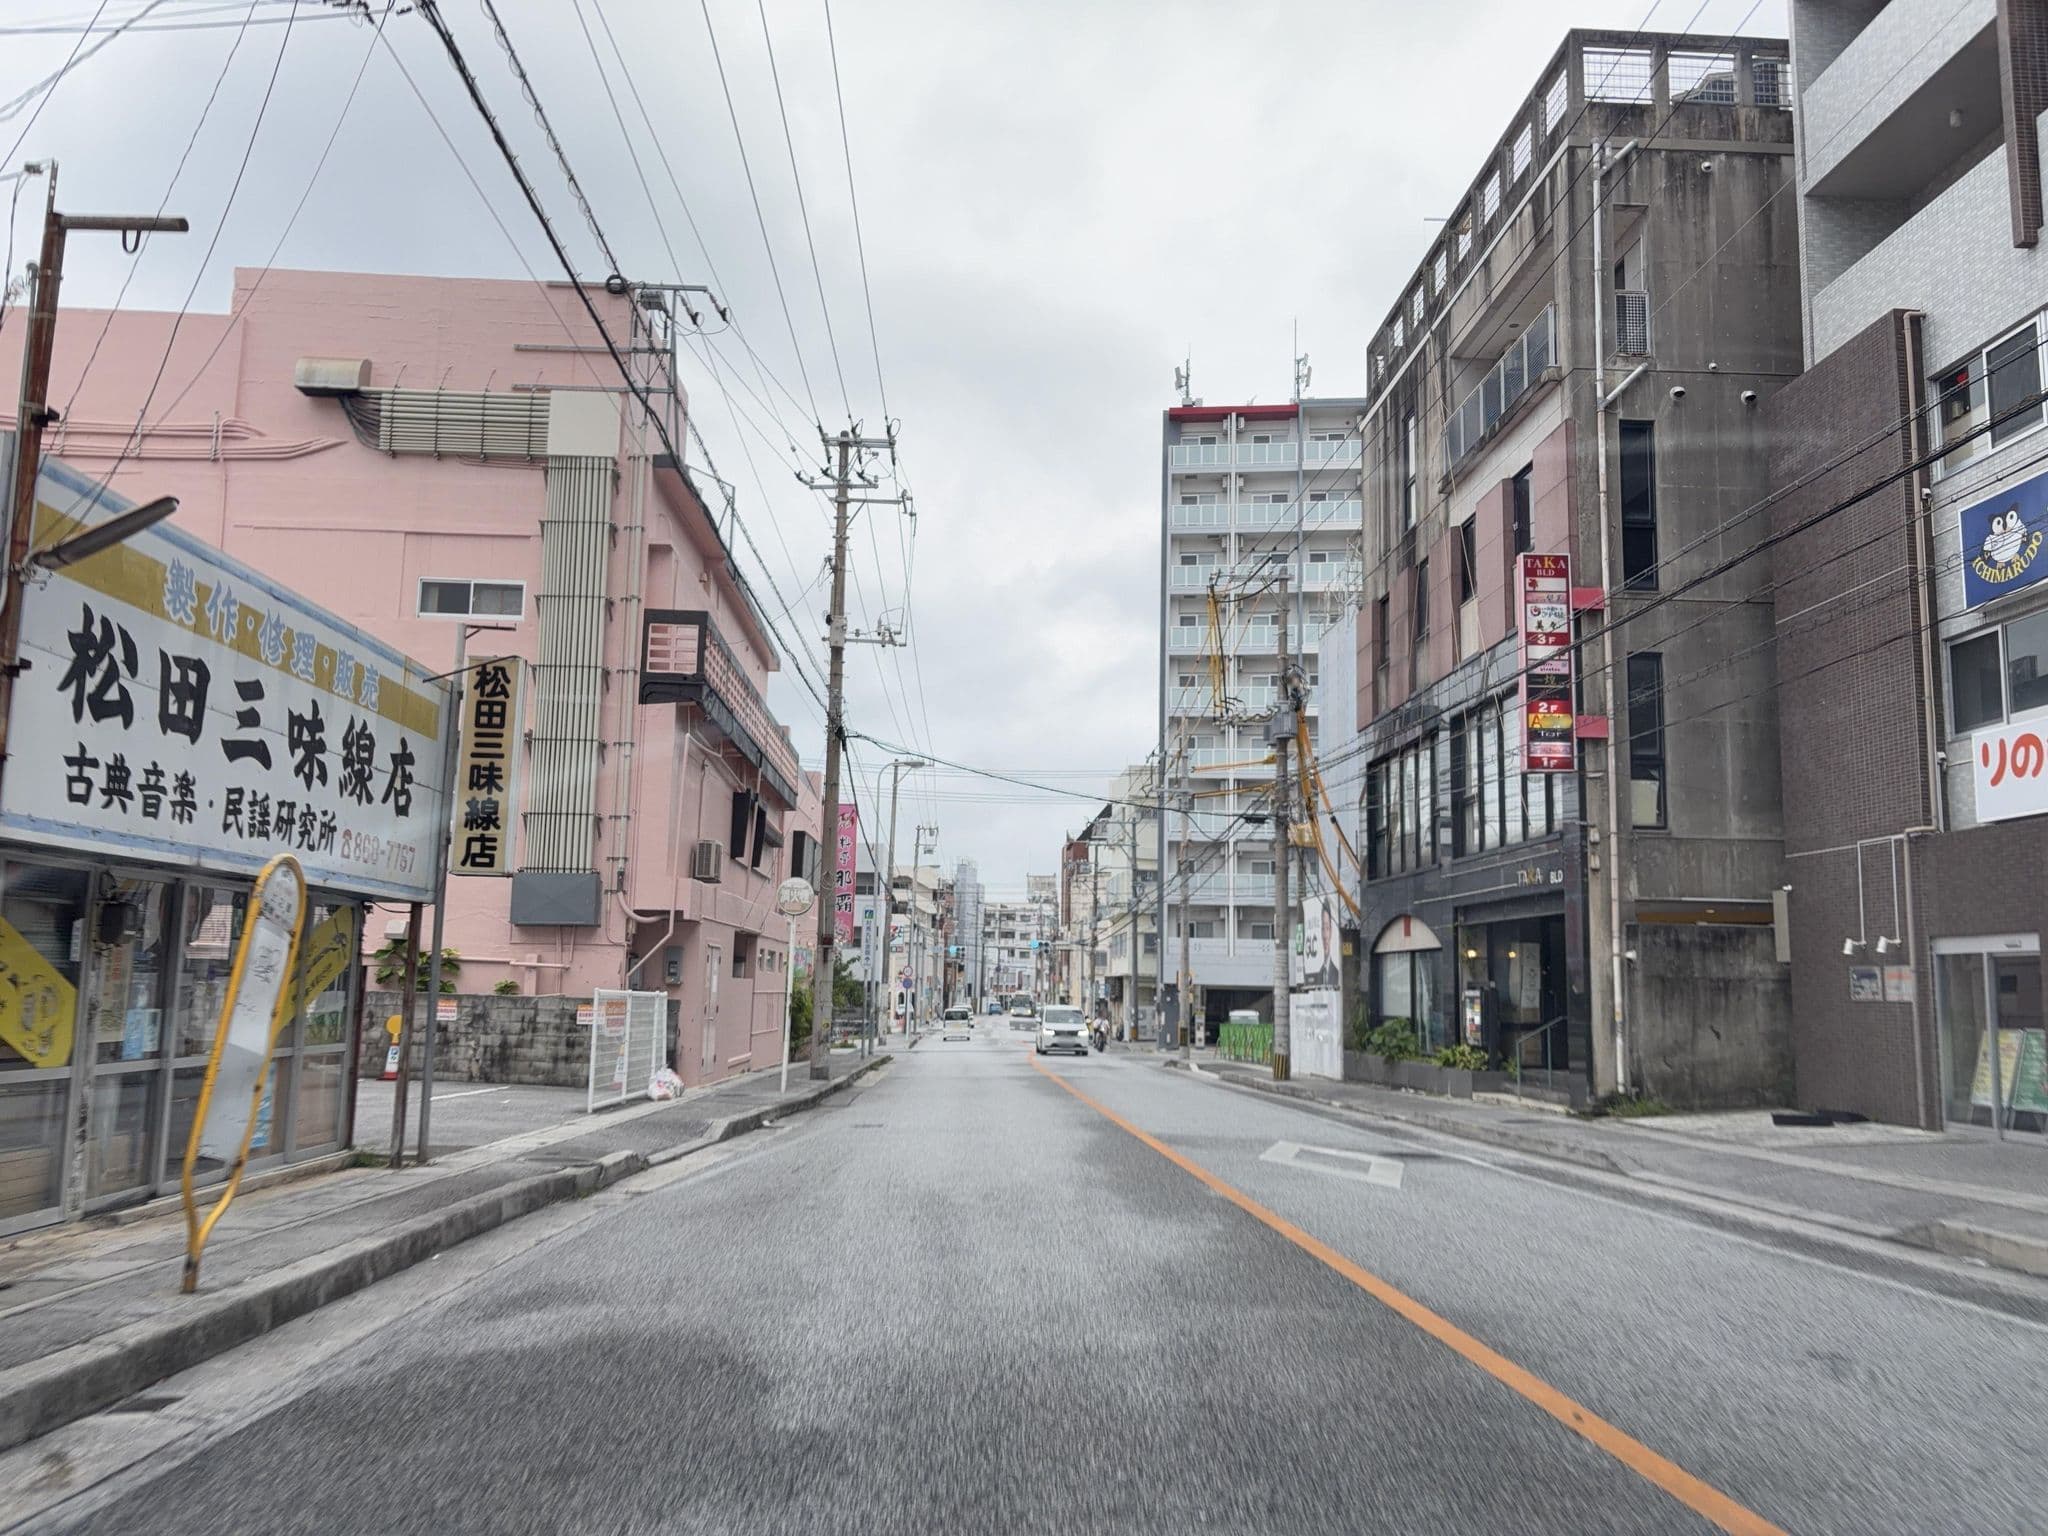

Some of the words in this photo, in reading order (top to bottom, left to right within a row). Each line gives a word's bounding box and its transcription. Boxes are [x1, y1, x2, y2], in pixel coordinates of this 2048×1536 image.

[1525, 557, 1566, 569] TAKA
[1536, 569, 1555, 577] BLD
[1971, 531, 2043, 583] ICHIMARUDO
[163, 557, 381, 713] 製作・修理・販売
[57, 602, 416, 818] 松田三味線店
[461, 663, 511, 869] 松田三味線店
[1982, 733, 2048, 787] りの
[63, 742, 337, 855] 古典音楽・民謡研究所
[1517, 866, 1543, 888] TAKA
